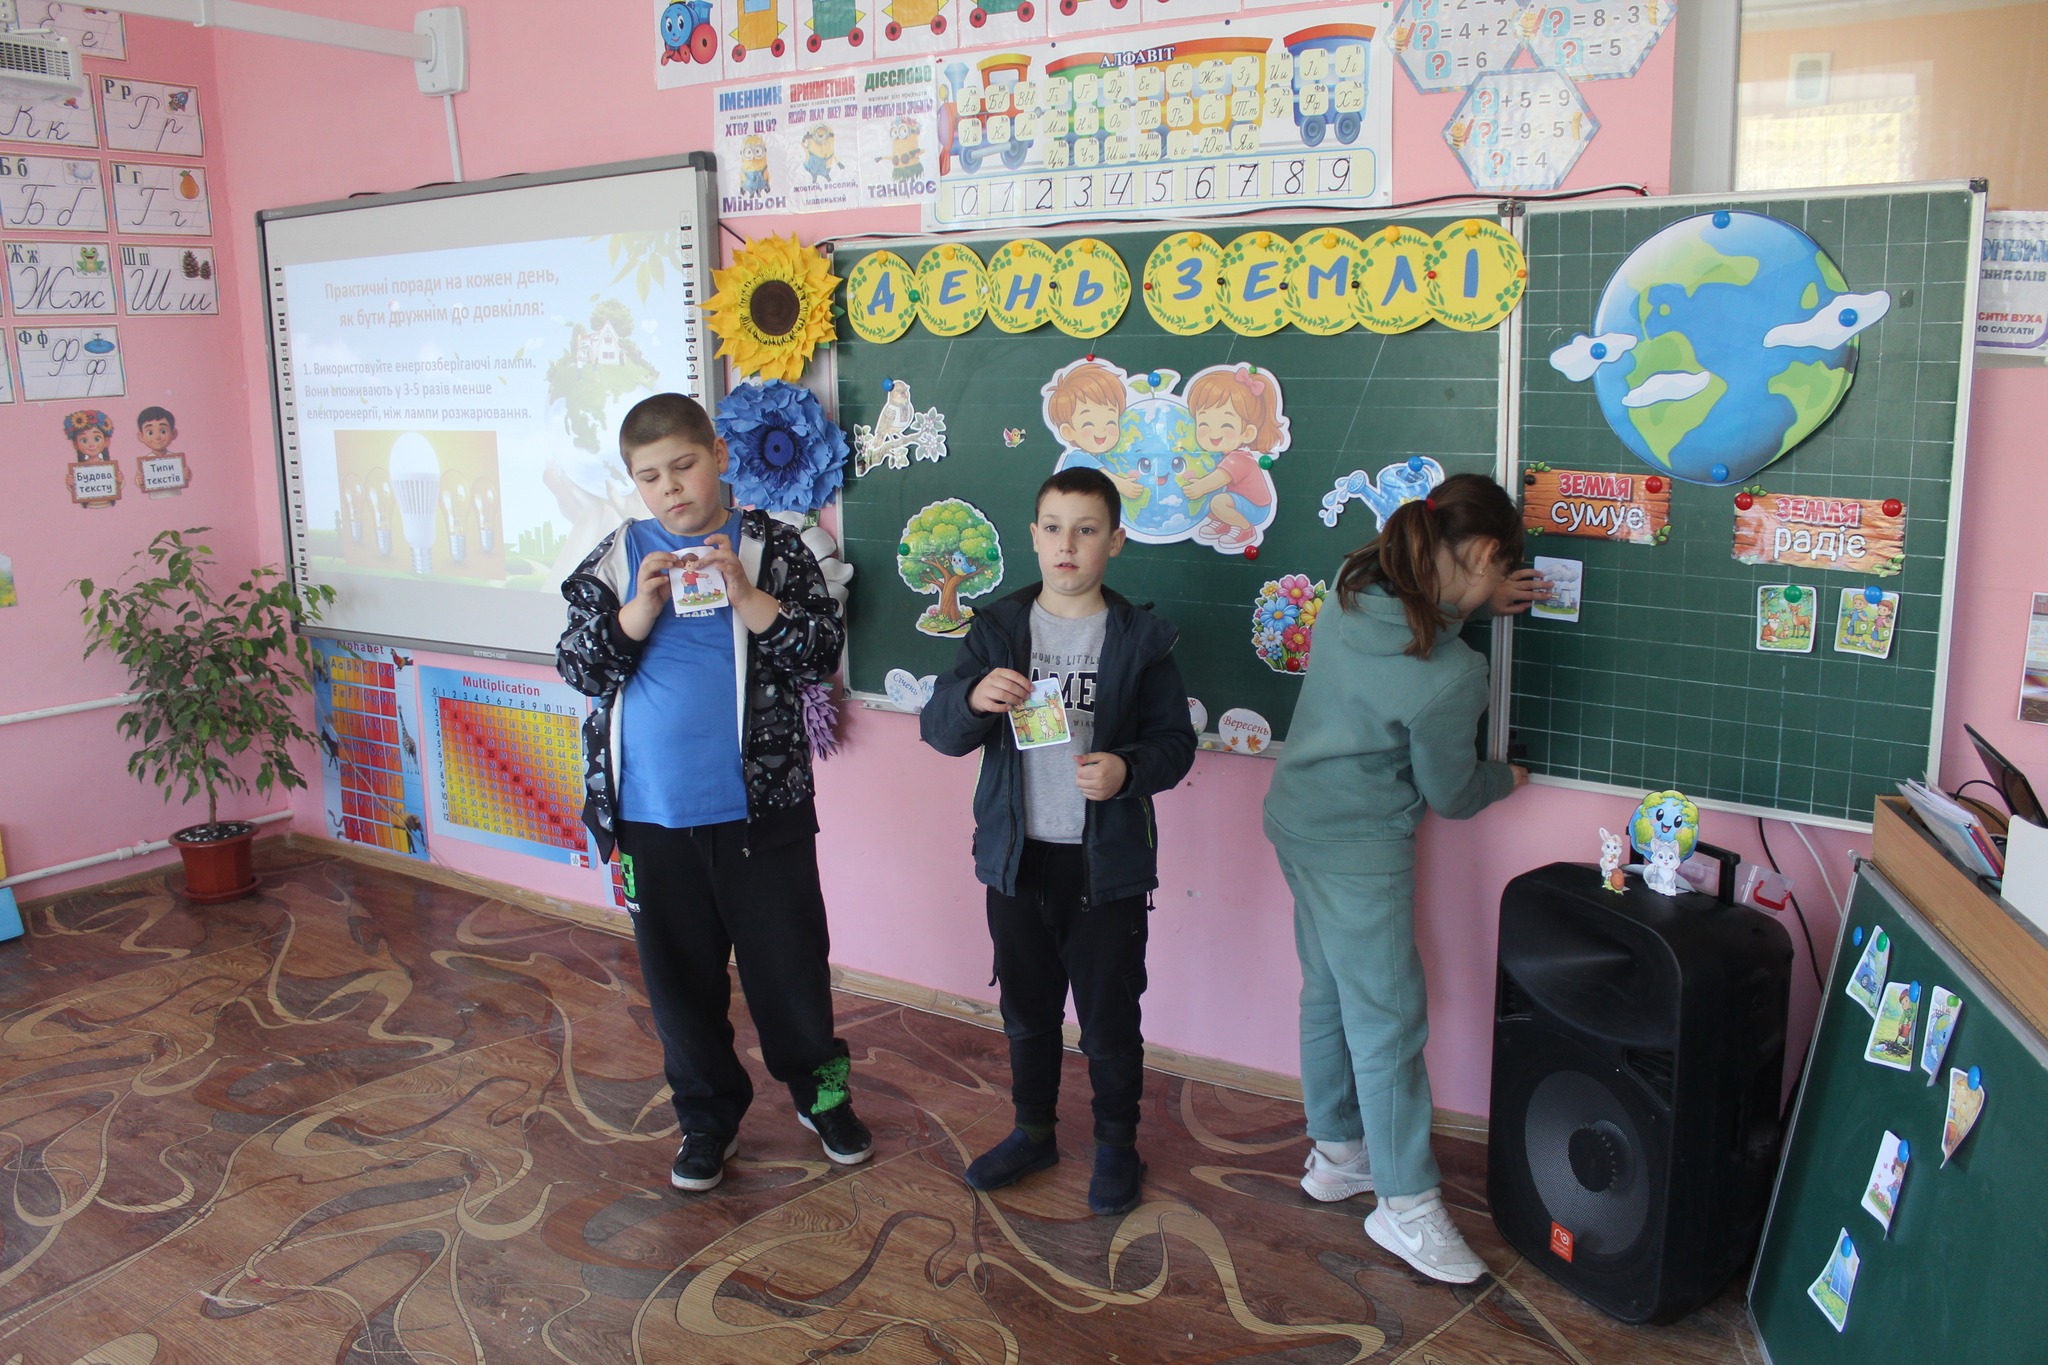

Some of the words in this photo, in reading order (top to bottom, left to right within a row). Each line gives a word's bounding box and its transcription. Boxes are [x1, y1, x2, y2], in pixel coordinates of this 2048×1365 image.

[1593, 9, 1606, 27] 8
[1627, 6, 1640, 24] 3
[1458, 23, 1472, 40] 4
[1477, 23, 1490, 37] +
[1497, 19, 1508, 37] 2
[1099, 46, 1176, 69] АЛФАВІТ
[1609, 39, 1622, 57] 5
[1476, 52, 1487, 68] 6
[789, 76, 857, 102] ПРИКМЕТНИК
[864, 65, 933, 93] ДІЄСЛОВО
[104, 79, 116, 94] Р
[120, 83, 131, 100] р
[719, 85, 783, 112] ІМЕННИК
[1501, 95, 1512, 107] +
[1520, 91, 1532, 108] 5
[1558, 89, 1571, 106] 9
[809, 107, 825, 122] ЯКА?
[862, 105, 872, 120] ЩО
[47, 120, 70, 140] к
[156, 117, 183, 152] р
[725, 122, 749, 137] ХТО?
[754, 118, 777, 134] ЩО?
[1520, 122, 1532, 139] 9
[1552, 121, 1565, 138] 5
[0, 157, 12, 176] Б
[17, 158, 28, 177] б
[1535, 151, 1547, 169] 4
[114, 164, 127, 184] Г
[132, 170, 142, 184] г
[793, 182, 823, 193] жовтий,
[824, 179, 859, 190] веселий,
[867, 180, 937, 199] танцює
[962, 186, 978, 215] 0
[1004, 182, 1015, 212] 1
[1036, 179, 1052, 209] 2
[1073, 176, 1092, 207] 3
[1110, 172, 1132, 205] 4
[1152, 169, 1173, 202] 5
[1195, 167, 1215, 199] 6
[1239, 164, 1259, 196] 7
[1284, 161, 1304, 194] 8
[1328, 158, 1350, 191] 9
[10, 184, 56, 226] Б
[57, 187, 96, 226] б
[132, 187, 169, 225] Г
[169, 210, 187, 227] г
[722, 194, 787, 213] Міньон
[805, 194, 847, 205] маленький
[7, 244, 25, 264] Ж
[27, 249, 39, 264] ж
[122, 247, 137, 265] Ш
[139, 251, 150, 266] ш
[16, 266, 75, 310] Ж
[69, 291, 105, 309] ж
[130, 268, 171, 311] Ш
[179, 293, 212, 311] ш
[325, 277, 388, 302] Практичні
[392, 278, 442, 296] поради
[445, 275, 462, 290] на
[466, 271, 513, 288] кожен
[517, 268, 559, 289] день,
[867, 269, 1104, 315] ДЕНЬ
[1173, 248, 1479, 306] ЗЕМЛІ
[340, 312, 354, 327] як
[357, 308, 385, 328] бути
[389, 304, 448, 328] дружнім
[452, 306, 470, 324] до
[473, 298, 544, 323] довкілля:
[2011, 313, 2043, 323] ВУХА
[19, 330, 32, 345] Ф
[37, 330, 48, 348] ф
[1990, 326, 2034, 335] СЛУХАТИ
[48, 338, 80, 376] Ф
[86, 359, 107, 396] ф
[303, 363, 312, 375] 1.
[314, 359, 393, 377] Використовуйте
[395, 355, 491, 375] енергозберігаючі
[494, 357, 536, 371] лампи.
[305, 385, 329, 397] Вони
[332, 382, 393, 398] споживають
[395, 385, 402, 398] у
[404, 382, 420, 395] 3-5
[423, 381, 450, 398] разів
[453, 383, 492, 395] менше
[307, 405, 381, 421] електроенергії,
[384, 405, 402, 419] ніж
[404, 407, 439, 421] лампи
[442, 406, 532, 421] розжарювання.
[76, 472, 113, 484] Будова
[150, 463, 175, 474] Типи
[79, 484, 113, 494] тексту
[147, 474, 181, 485] текстів
[1558, 473, 1632, 501] ЗЕМЛЯ
[1551, 500, 1645, 536] сумує
[1775, 497, 1862, 528] ЗЕМЛЯ
[1773, 525, 1867, 561] радіє
[463, 676, 540, 696] Multiplication
[453, 690, 457, 698] 2
[463, 692, 468, 700] 3
[486, 695, 490, 703] 5
[497, 697, 502, 705] 6
[508, 698, 513, 706] 7
[521, 700, 525, 709] 8
[532, 702, 537, 710] 9
[544, 704, 551, 712] 10
[556, 705, 563, 713] 11
[569, 707, 576, 715] 12
[1223, 715, 1270, 736] Вересень
